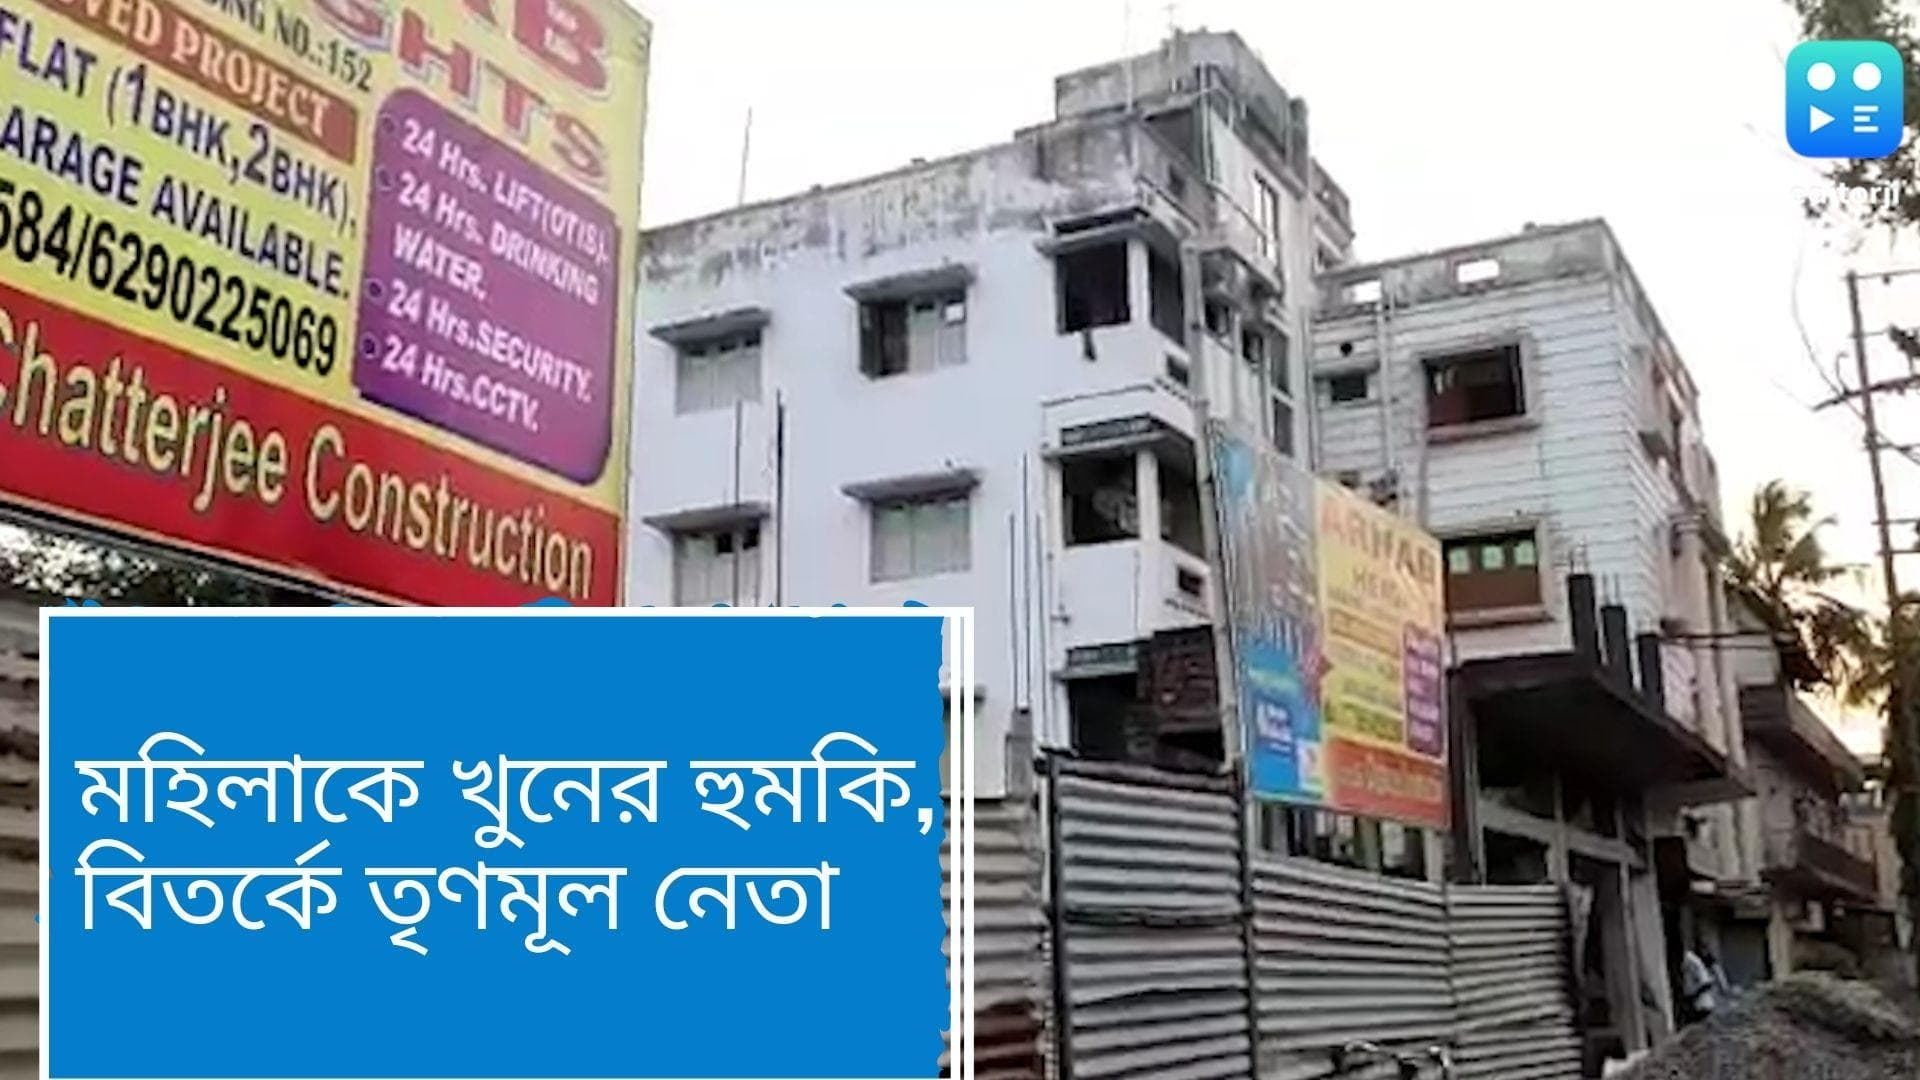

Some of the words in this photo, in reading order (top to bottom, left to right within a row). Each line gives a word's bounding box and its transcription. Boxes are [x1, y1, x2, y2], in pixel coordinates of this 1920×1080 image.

[0, 7, 97, 98] FLAT
[58, 0, 163, 47] ED
[170, 17, 331, 139] PROJECT
[462, 0, 608, 96] B
[0, 104, 142, 206] ARAGE
[151, 174, 349, 298] AVAILABLE.
[401, 118, 435, 160] 24
[439, 140, 488, 192] Hrs.
[393, 222, 488, 301] WATER.
[399, 172, 432, 214] 24
[435, 192, 484, 246] Hrs.
[489, 220, 599, 305] DRINKING
[387, 279, 424, 323] 24
[381, 334, 417, 376] 24
[306, 424, 593, 600] Construction
